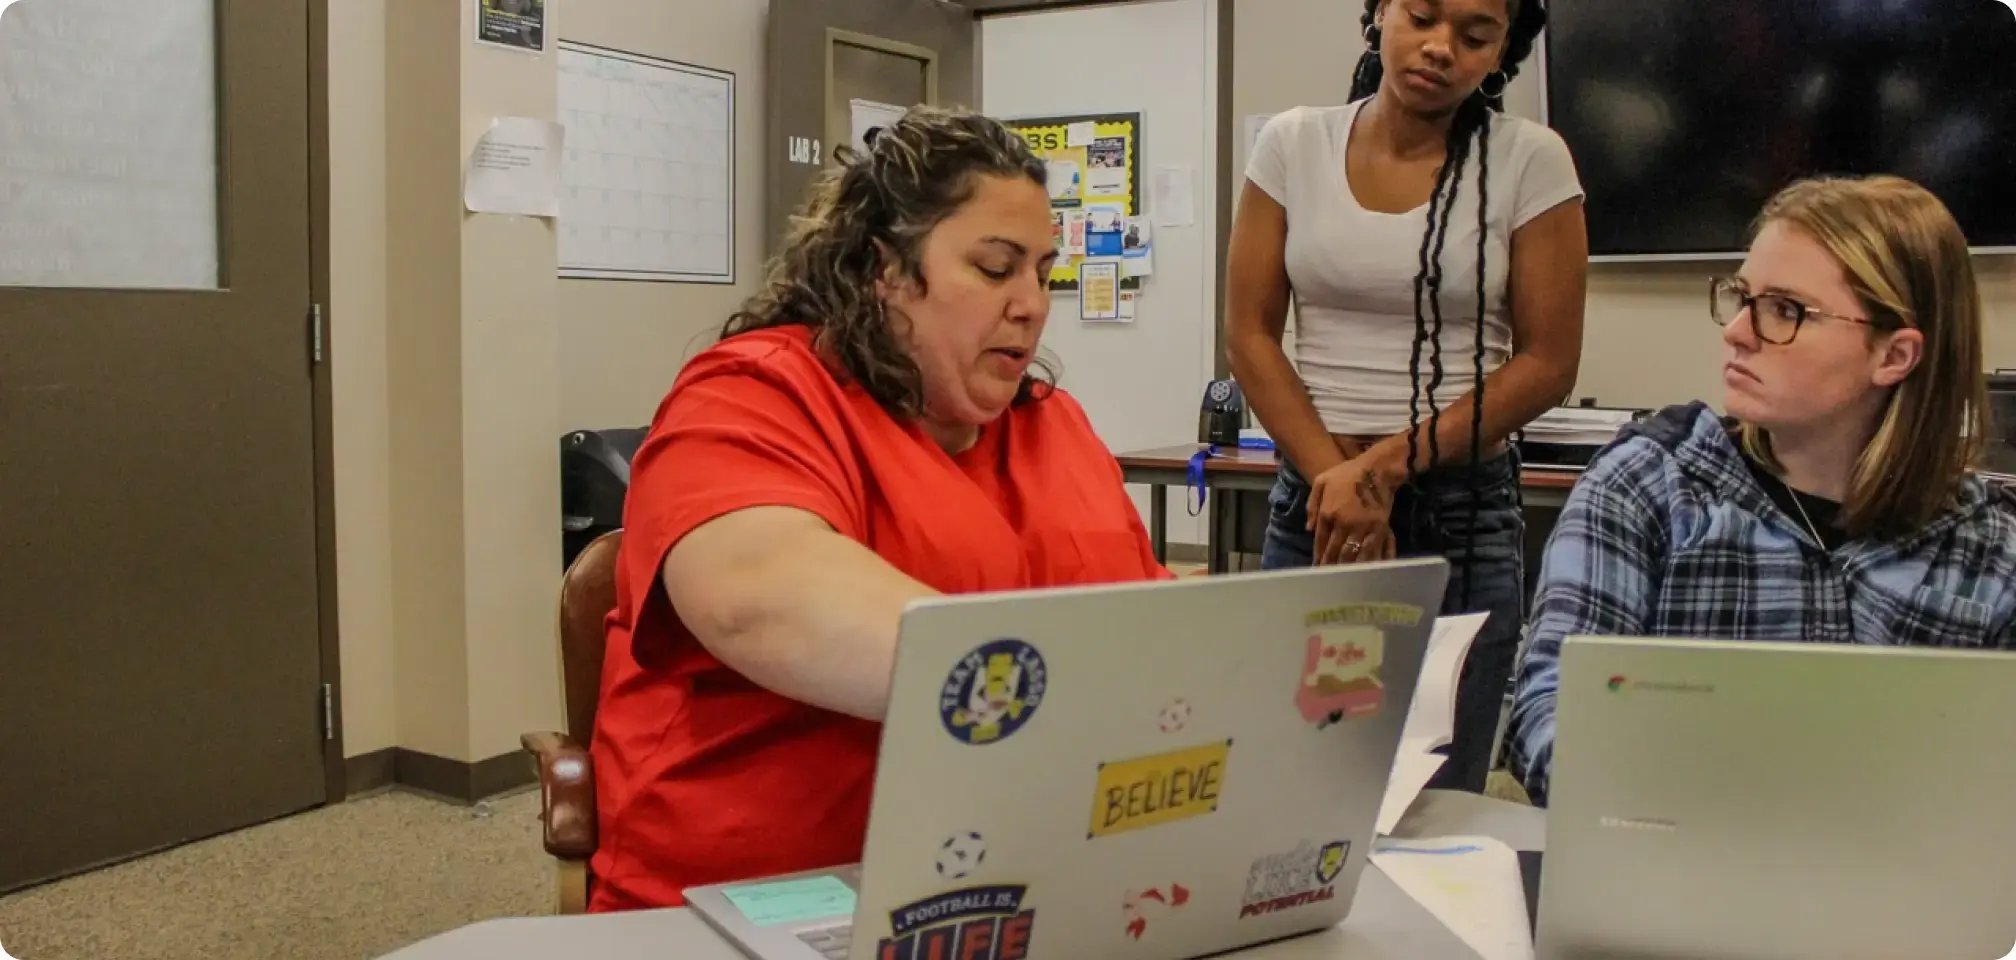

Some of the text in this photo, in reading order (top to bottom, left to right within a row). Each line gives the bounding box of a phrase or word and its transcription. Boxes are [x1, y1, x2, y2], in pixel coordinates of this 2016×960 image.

[789, 136, 820, 165] LAB 2
[942, 646, 1046, 711] TEAM LASSO
[1103, 761, 1220, 828] BELIEVE
[905, 894, 991, 926] FOOTBALL
